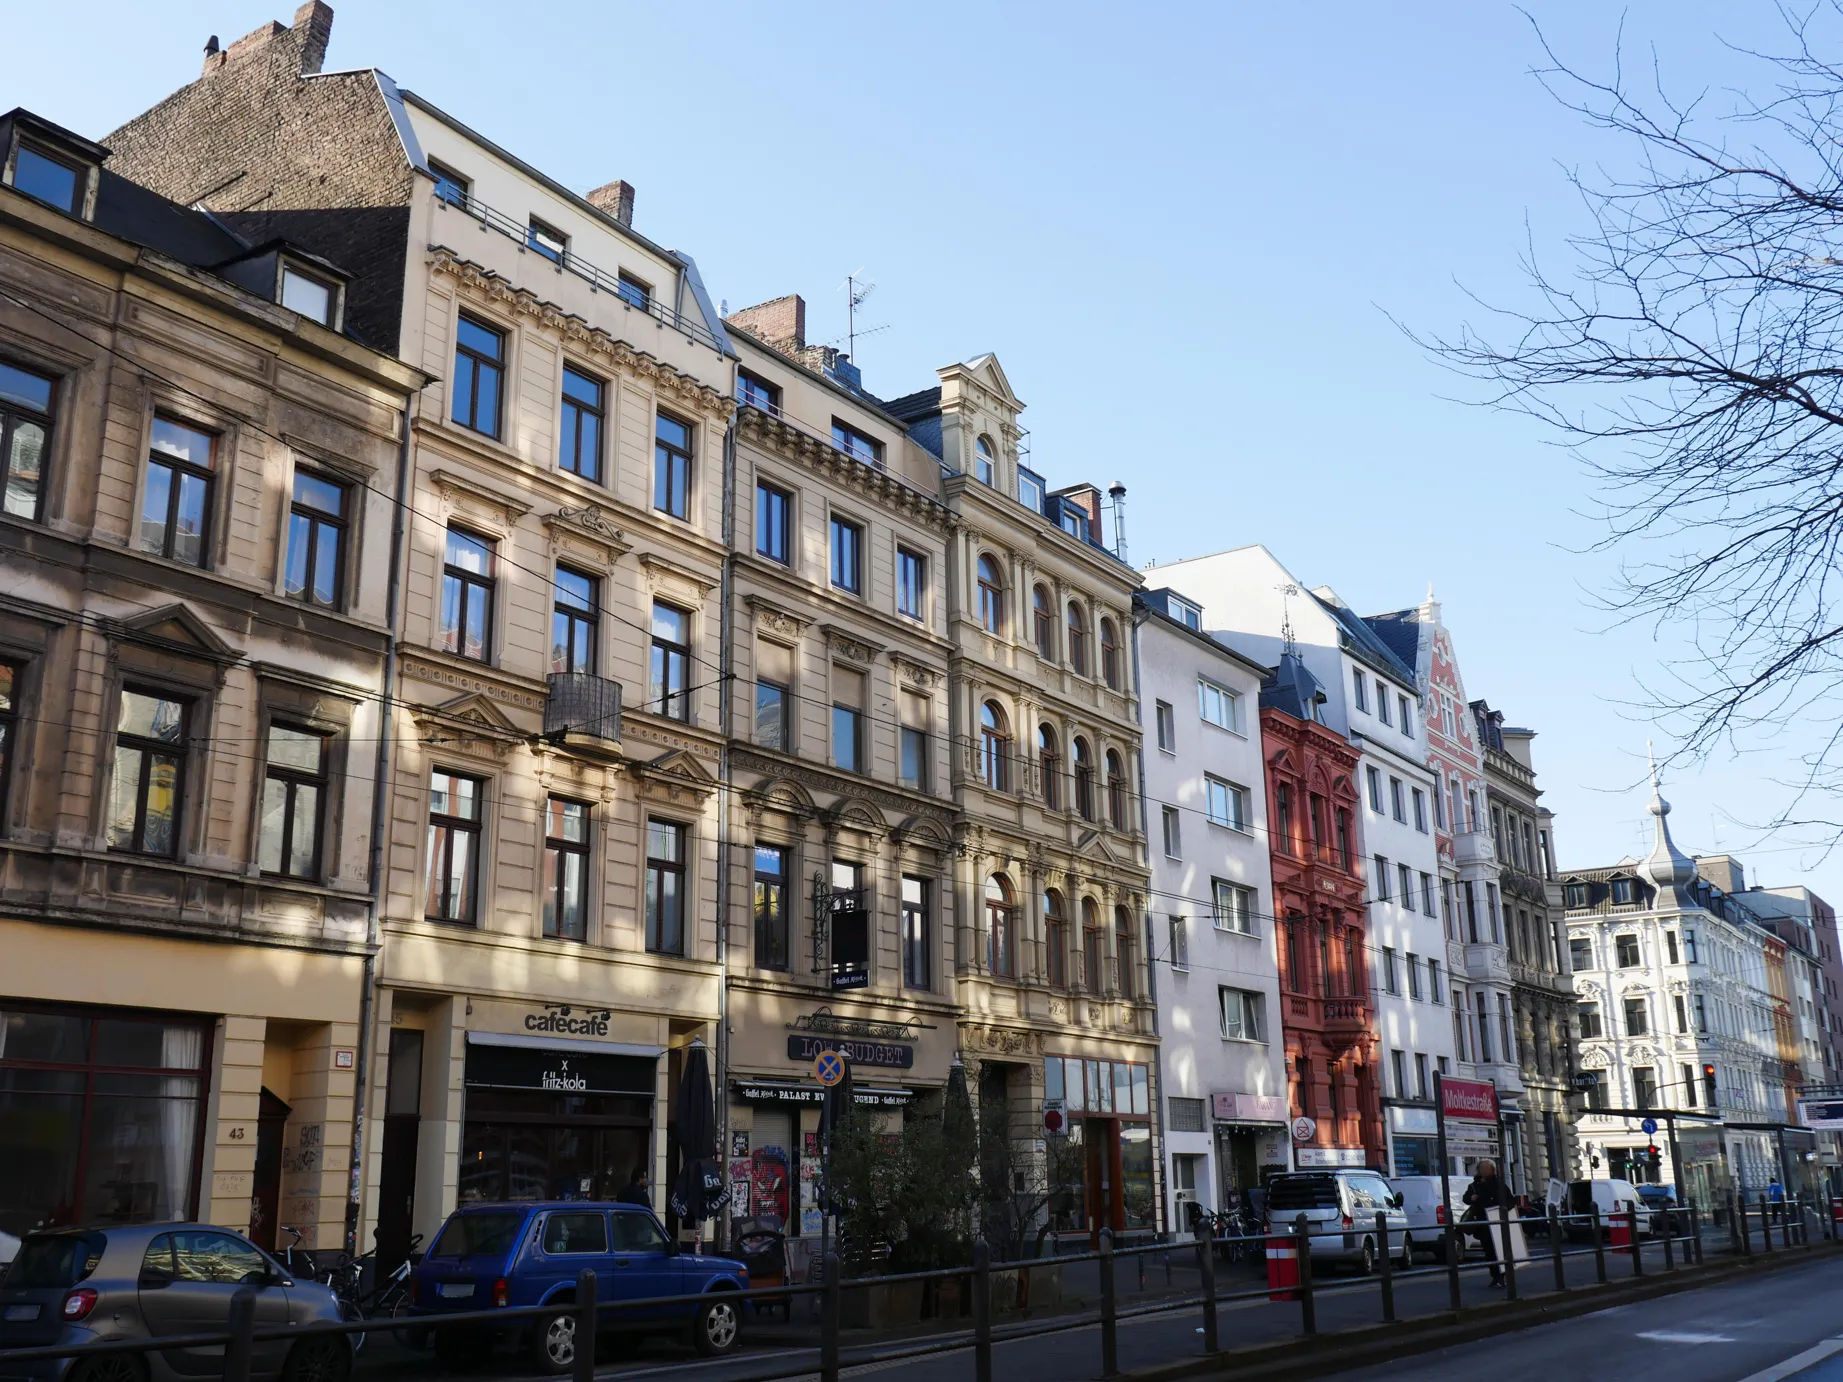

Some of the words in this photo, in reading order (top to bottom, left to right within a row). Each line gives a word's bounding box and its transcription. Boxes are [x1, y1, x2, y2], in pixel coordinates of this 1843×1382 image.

[844, 1042, 902, 1065] BUDGET
[542, 1071, 586, 1090] fritz-kola
[779, 1091, 811, 1101] PALAST
[1444, 1088, 1492, 1113] Moltkestraße
[229, 1128, 244, 1140] 43
